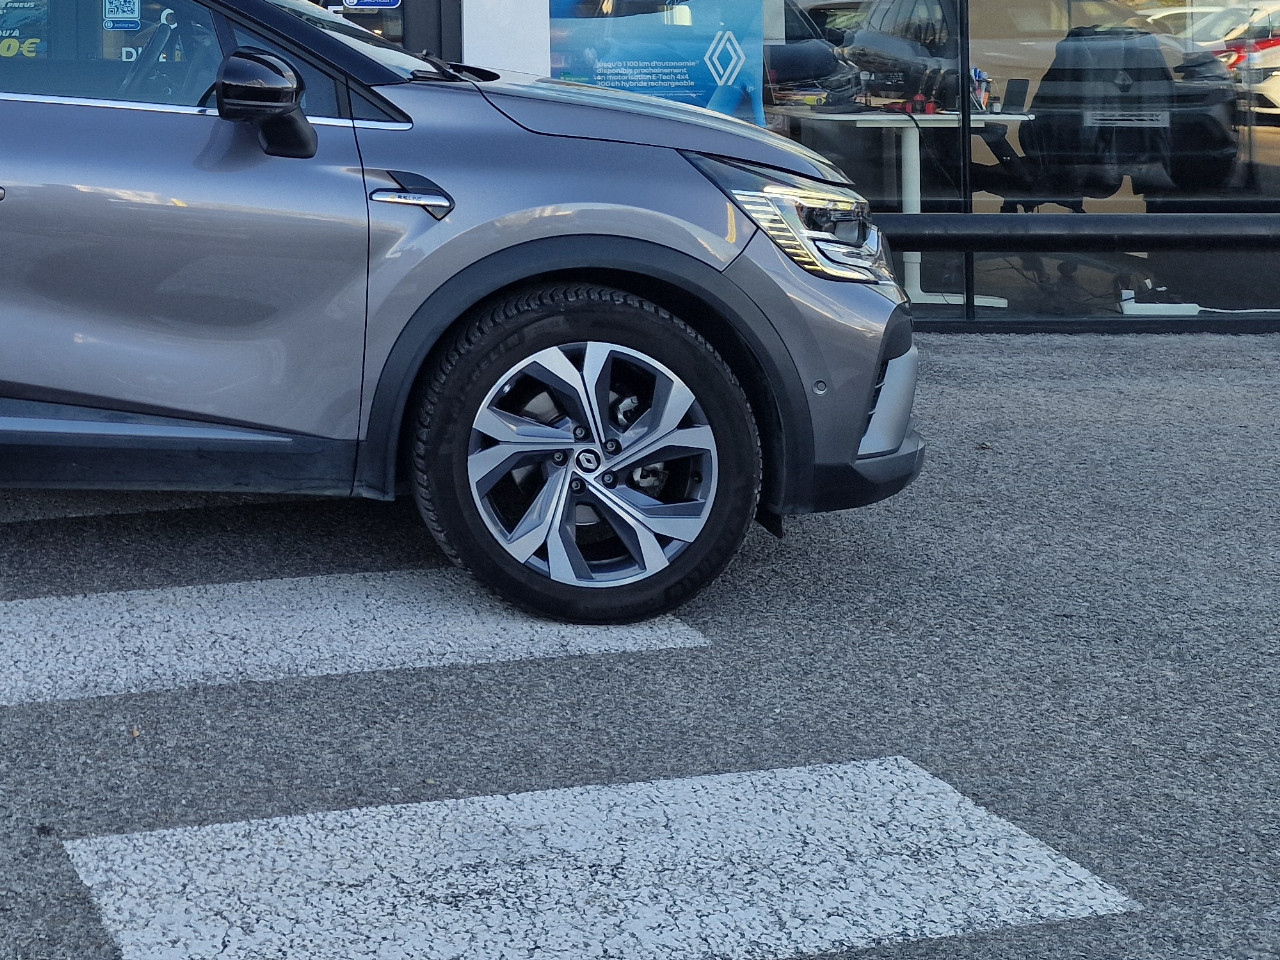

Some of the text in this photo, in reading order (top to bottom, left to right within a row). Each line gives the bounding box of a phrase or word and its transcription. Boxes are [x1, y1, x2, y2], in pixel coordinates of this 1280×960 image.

[596, 60, 622, 68] jusqu'à
[597, 67, 687, 75] disponible prochainement
[621, 80, 647, 88] hybride
[648, 79, 695, 88] rechargeable
